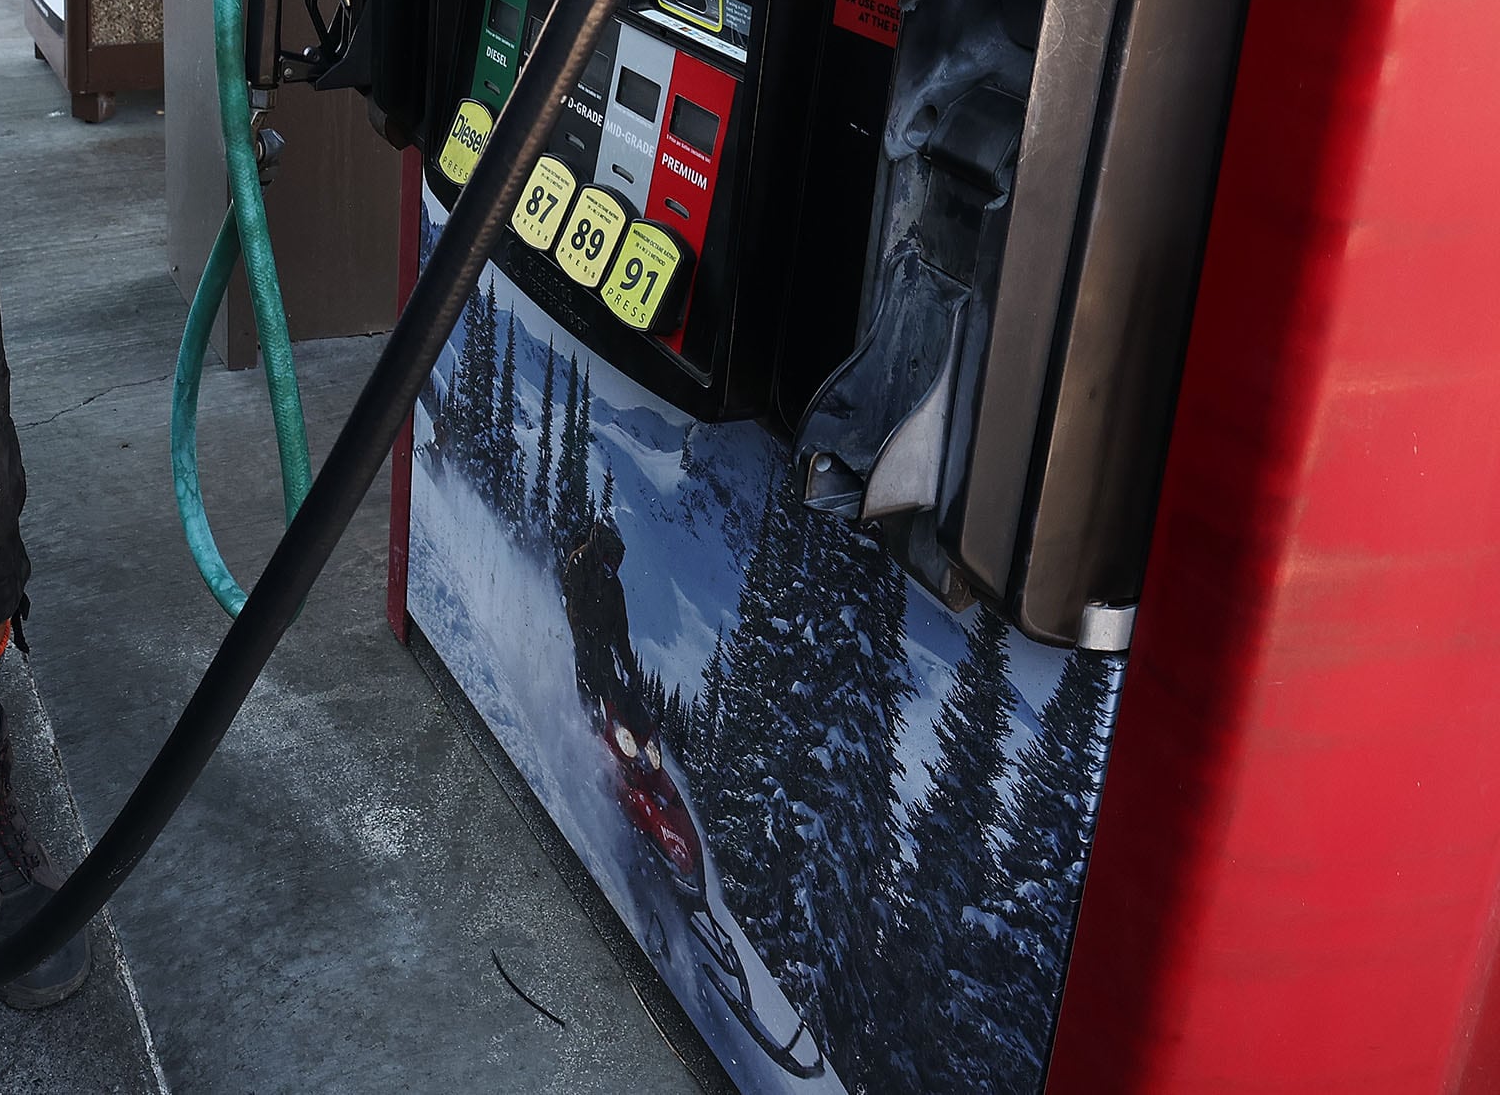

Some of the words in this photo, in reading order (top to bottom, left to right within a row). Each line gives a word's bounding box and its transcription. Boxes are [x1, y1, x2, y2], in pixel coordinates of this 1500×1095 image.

[858, 12, 871, 23] AT
[871, 15, 890, 30] THE
[485, 45, 508, 68] DIESEL
[451, 113, 488, 155] Diesel
[604, 119, 656, 159] MID-GRADE
[442, 156, 469, 181] PRESS
[661, 152, 709, 191] PREMIUM
[525, 185, 559, 224] 87
[571, 218, 605, 261] 89
[560, 246, 596, 279] PRESS
[620, 257, 659, 306] 91
[605, 287, 646, 324] PRESS
